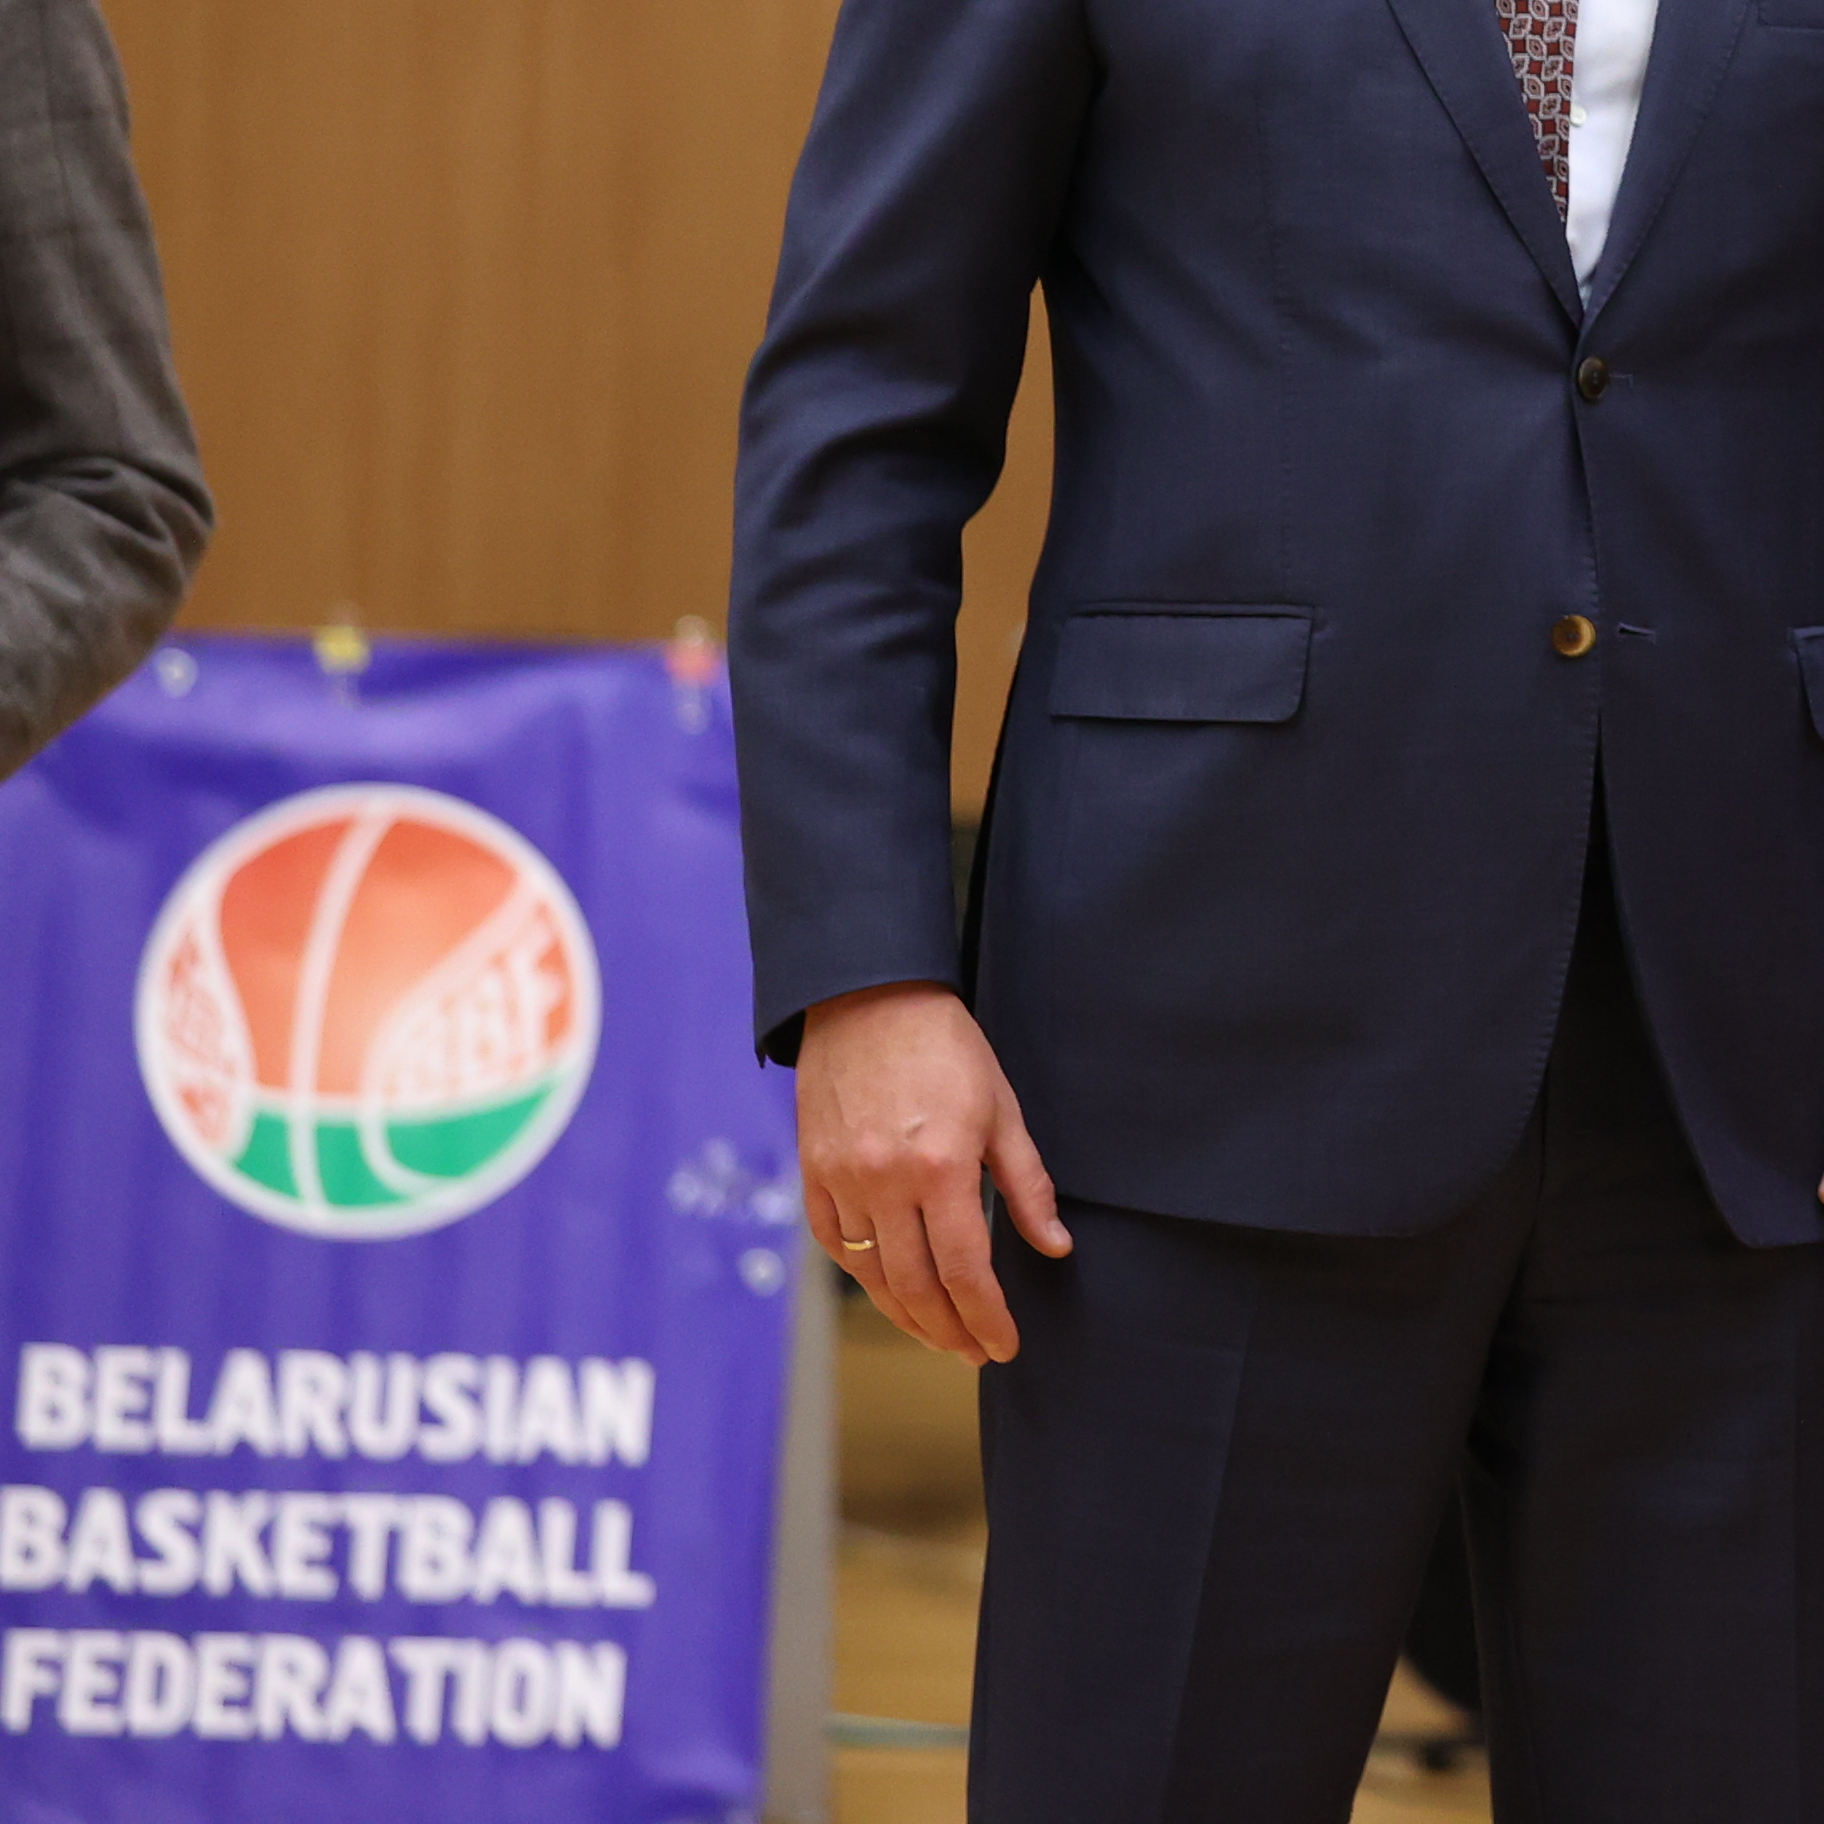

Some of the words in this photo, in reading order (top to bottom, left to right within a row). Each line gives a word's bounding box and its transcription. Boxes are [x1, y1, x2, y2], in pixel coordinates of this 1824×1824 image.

[17, 1342, 655, 1466] BELARUSIAN
[0, 1484, 655, 1608] BASKETBALL
[0, 1627, 626, 1748] FEDERATION
